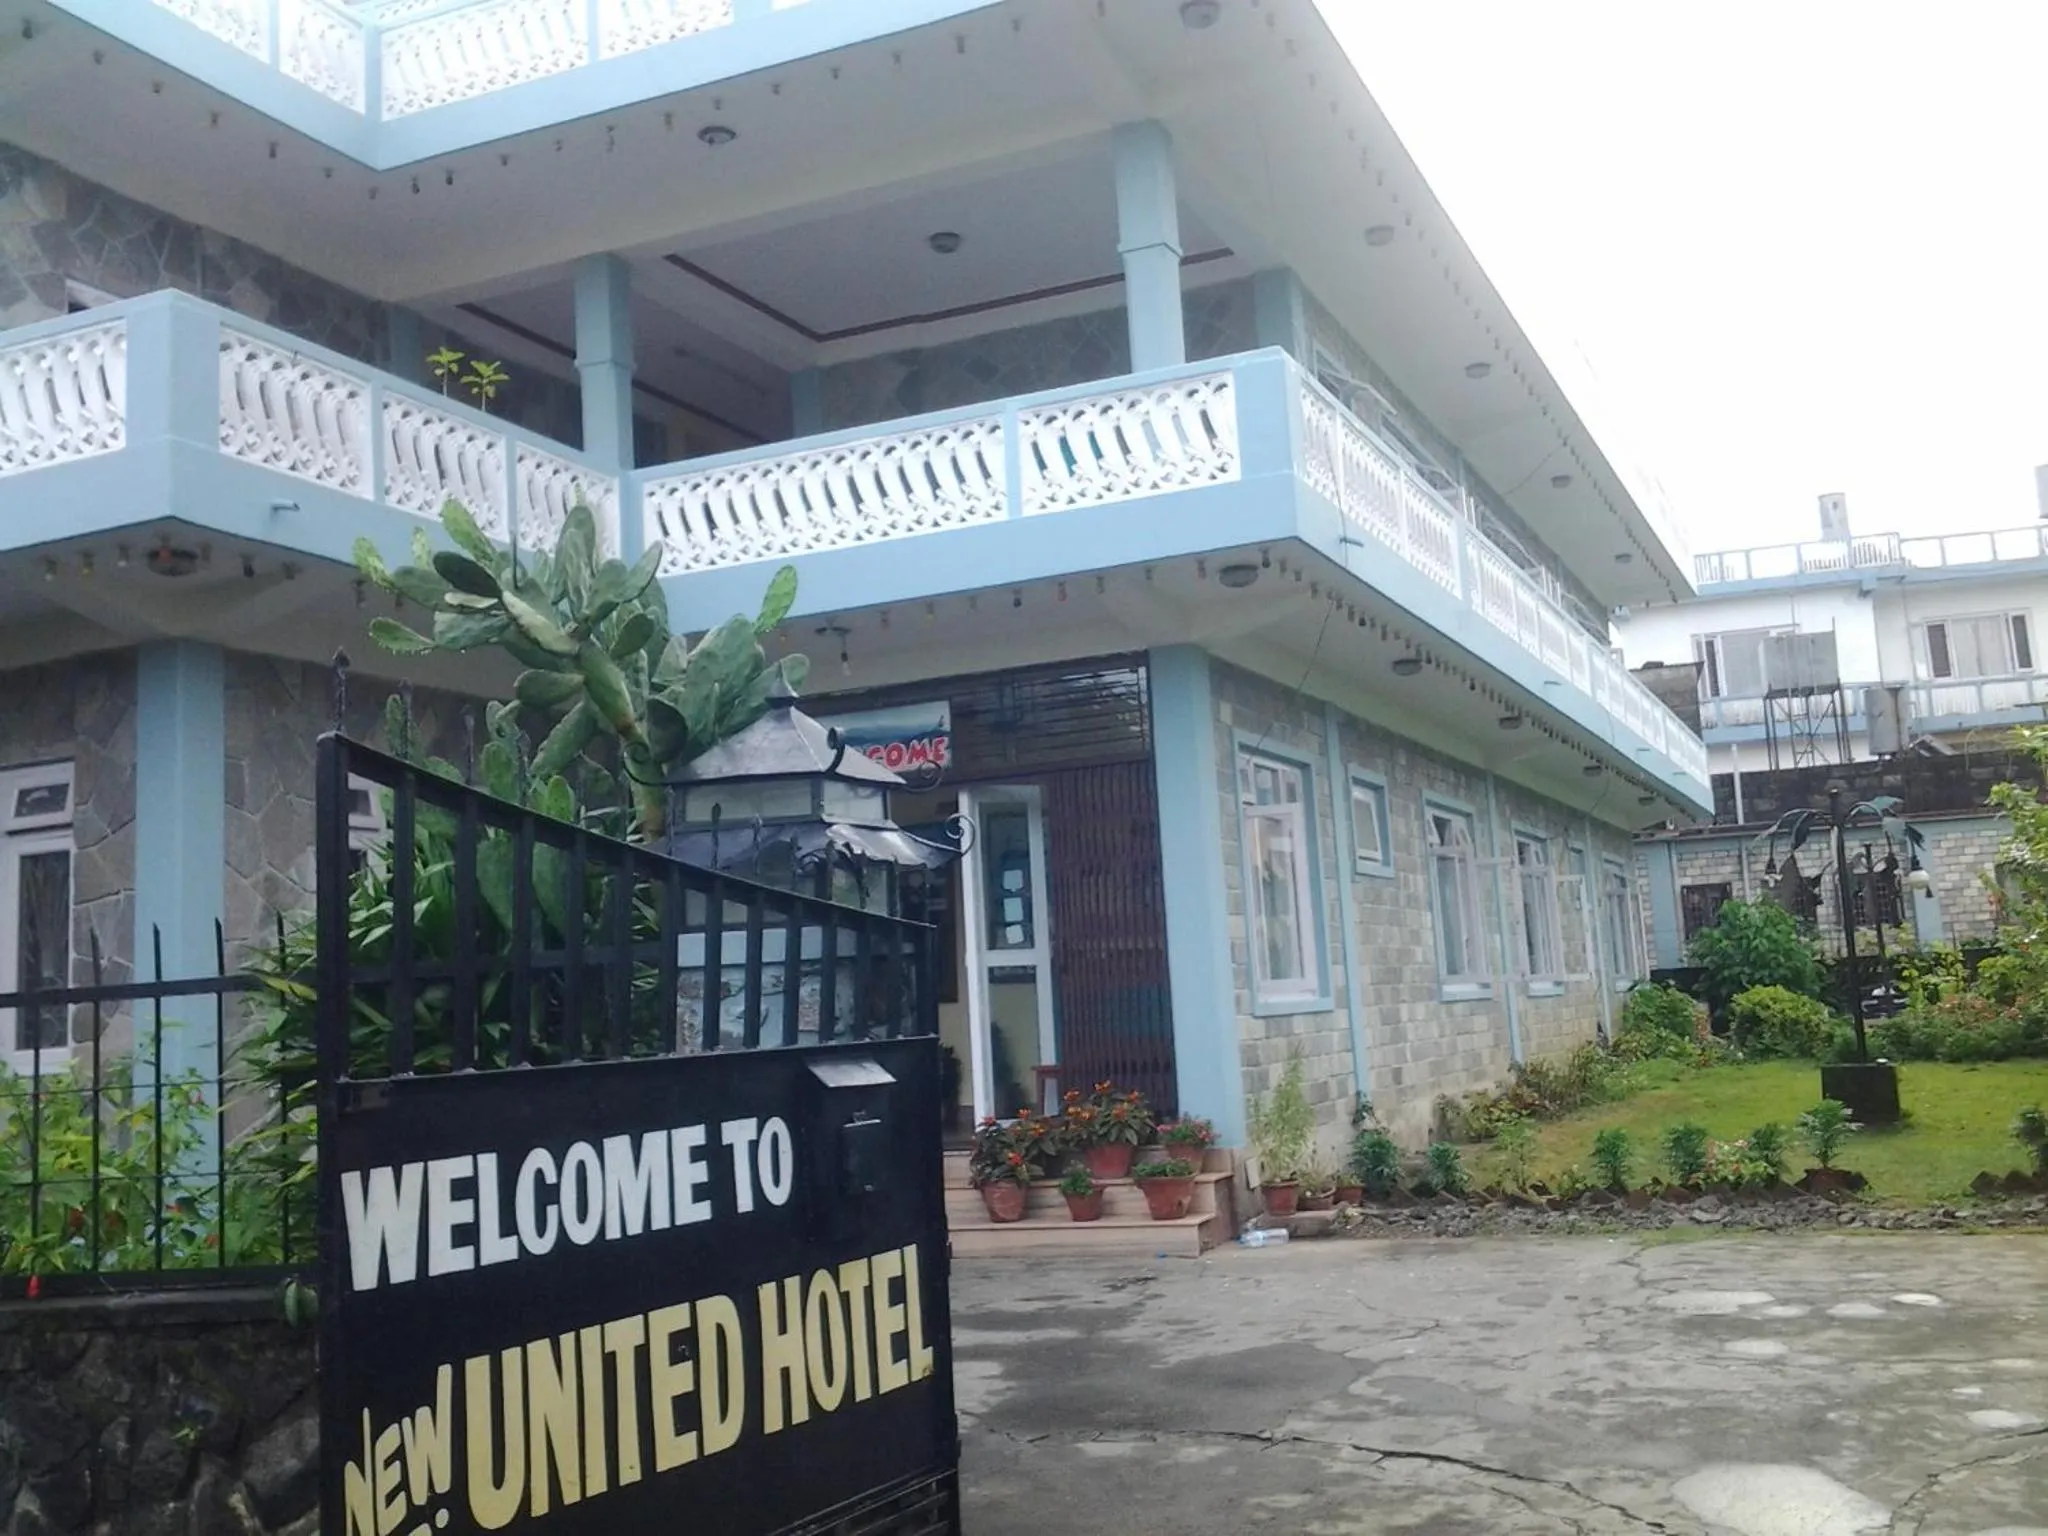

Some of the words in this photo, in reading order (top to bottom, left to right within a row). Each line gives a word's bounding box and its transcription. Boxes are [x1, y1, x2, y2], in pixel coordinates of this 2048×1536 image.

[865, 736, 949, 772] COME
[341, 1124, 712, 1291] WELCOME
[721, 1116, 793, 1214] TO
[344, 1363, 453, 1536] NEW
[465, 1294, 744, 1530] UNITED
[757, 1243, 934, 1435] HOTEL
